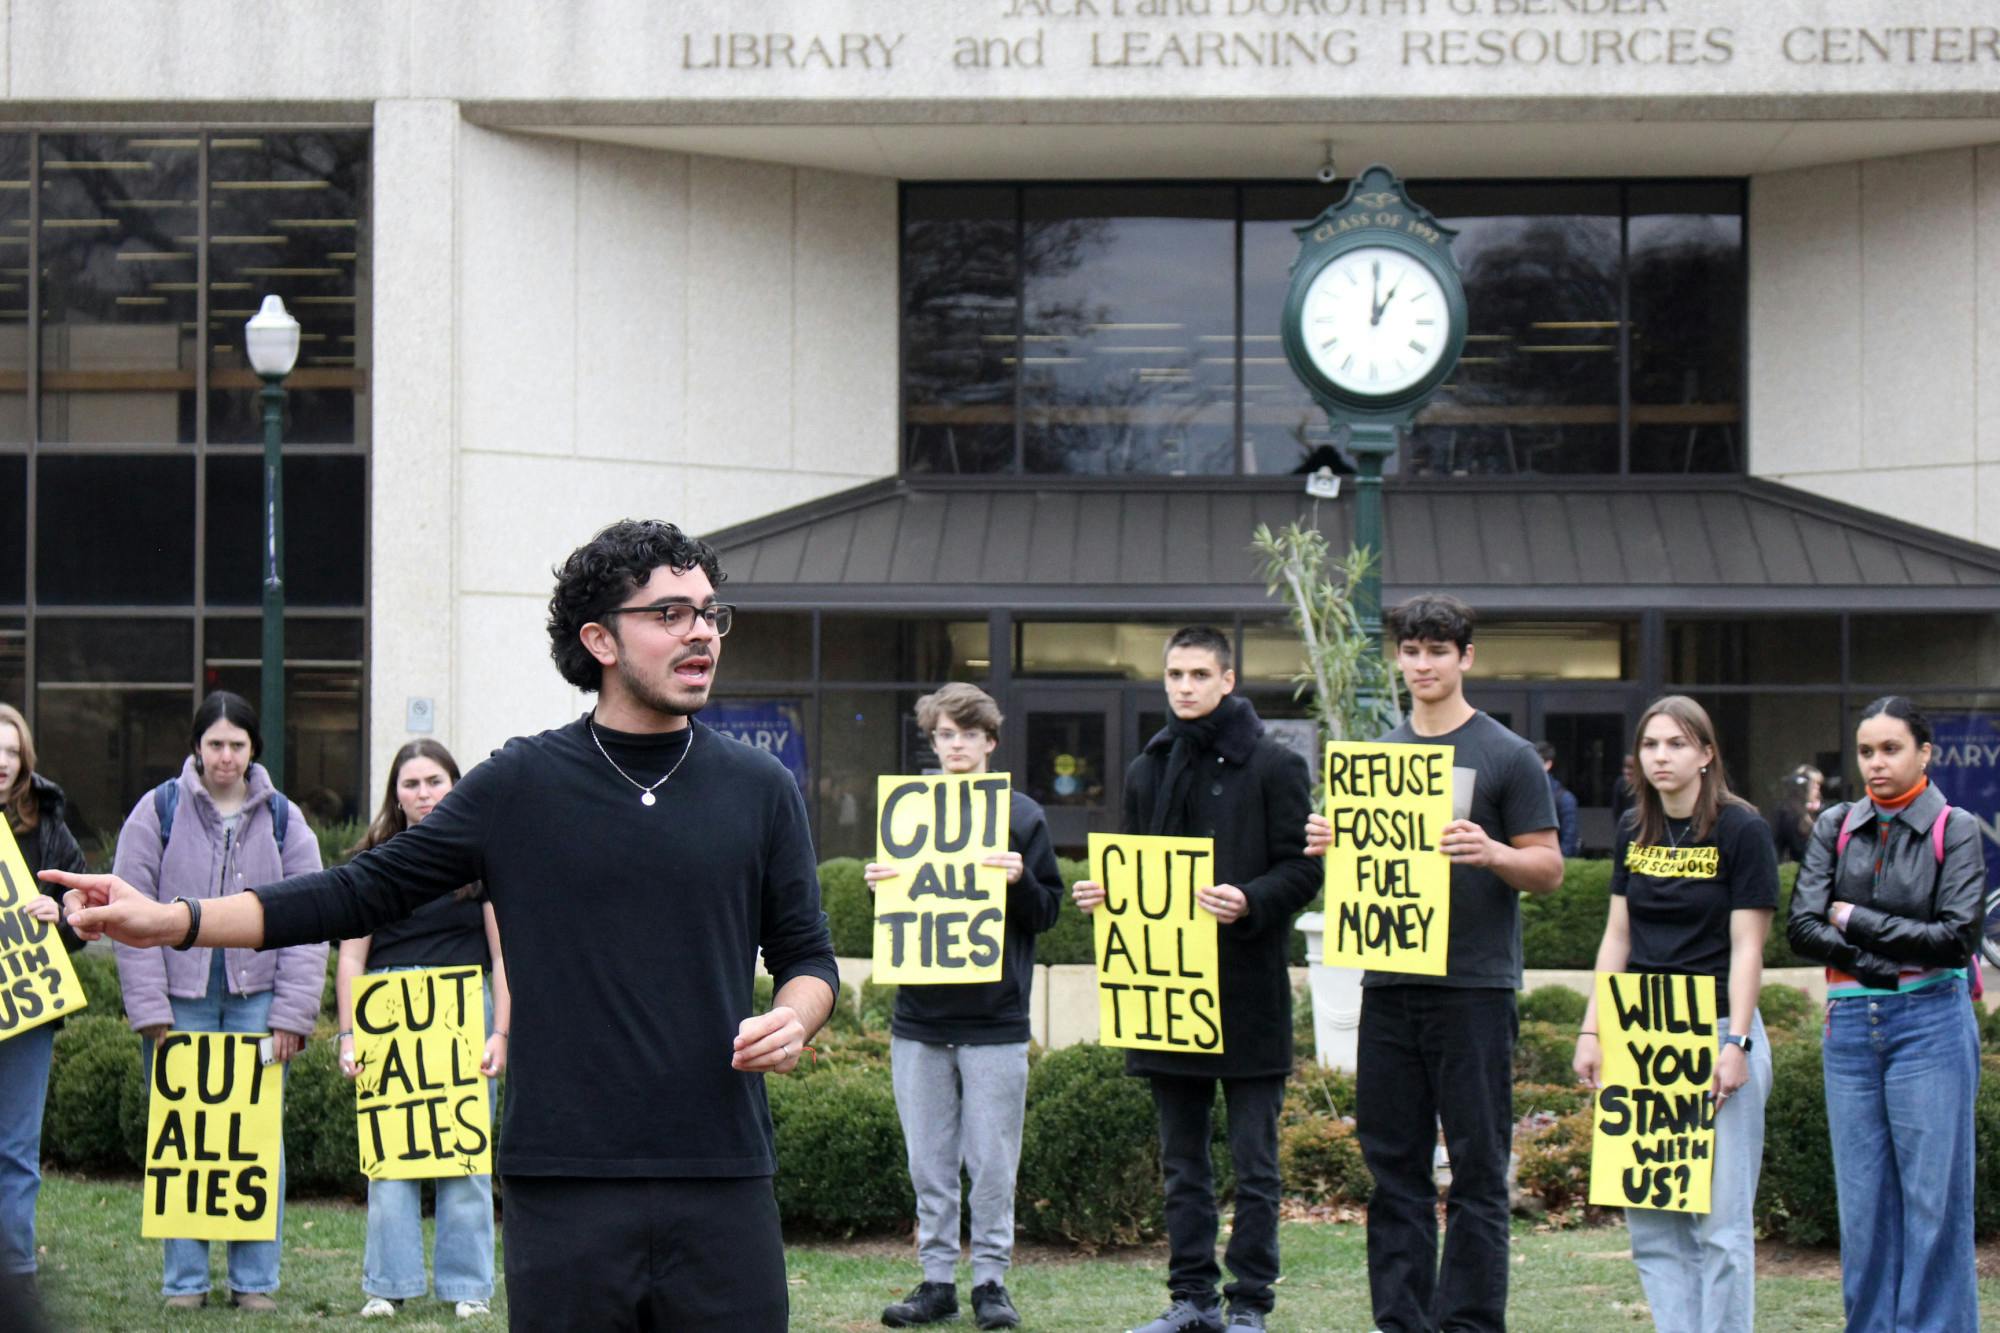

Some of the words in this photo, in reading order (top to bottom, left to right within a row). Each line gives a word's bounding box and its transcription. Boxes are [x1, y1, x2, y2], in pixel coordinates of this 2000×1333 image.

[682, 33, 904, 69] LIBRARY
[953, 32, 1044, 69] and
[1090, 31, 1358, 67] LEARNING
[1403, 29, 1736, 66] RESOURCES
[1783, 27, 2000, 62] CENTER
[1314, 213, 1370, 243] CLASS
[1330, 752, 1444, 797] REFUSE
[880, 779, 1008, 860] CUT
[1334, 807, 1434, 851] FOSSIL
[908, 862, 990, 901] ALL
[1102, 844, 1209, 920] CUT
[1357, 855, 1421, 898] FUEL
[879, 908, 1003, 968] TIES
[1102, 921, 1203, 978] ALL
[1338, 901, 1434, 956] MONEY
[355, 969, 478, 1034] CUT
[1100, 982, 1219, 1050] TIES
[1608, 974, 1712, 1036] WILL
[156, 1035, 262, 1104] CUT
[378, 1038, 478, 1096] ALL
[1626, 1040, 1711, 1086] YOU
[152, 1110, 259, 1162] ALL
[358, 1095, 488, 1163] TIES
[1598, 1084, 1715, 1137] STAND
[1631, 1136, 1709, 1165] WITH
[147, 1166, 267, 1221] TIES
[1622, 1164, 1692, 1208] US?
